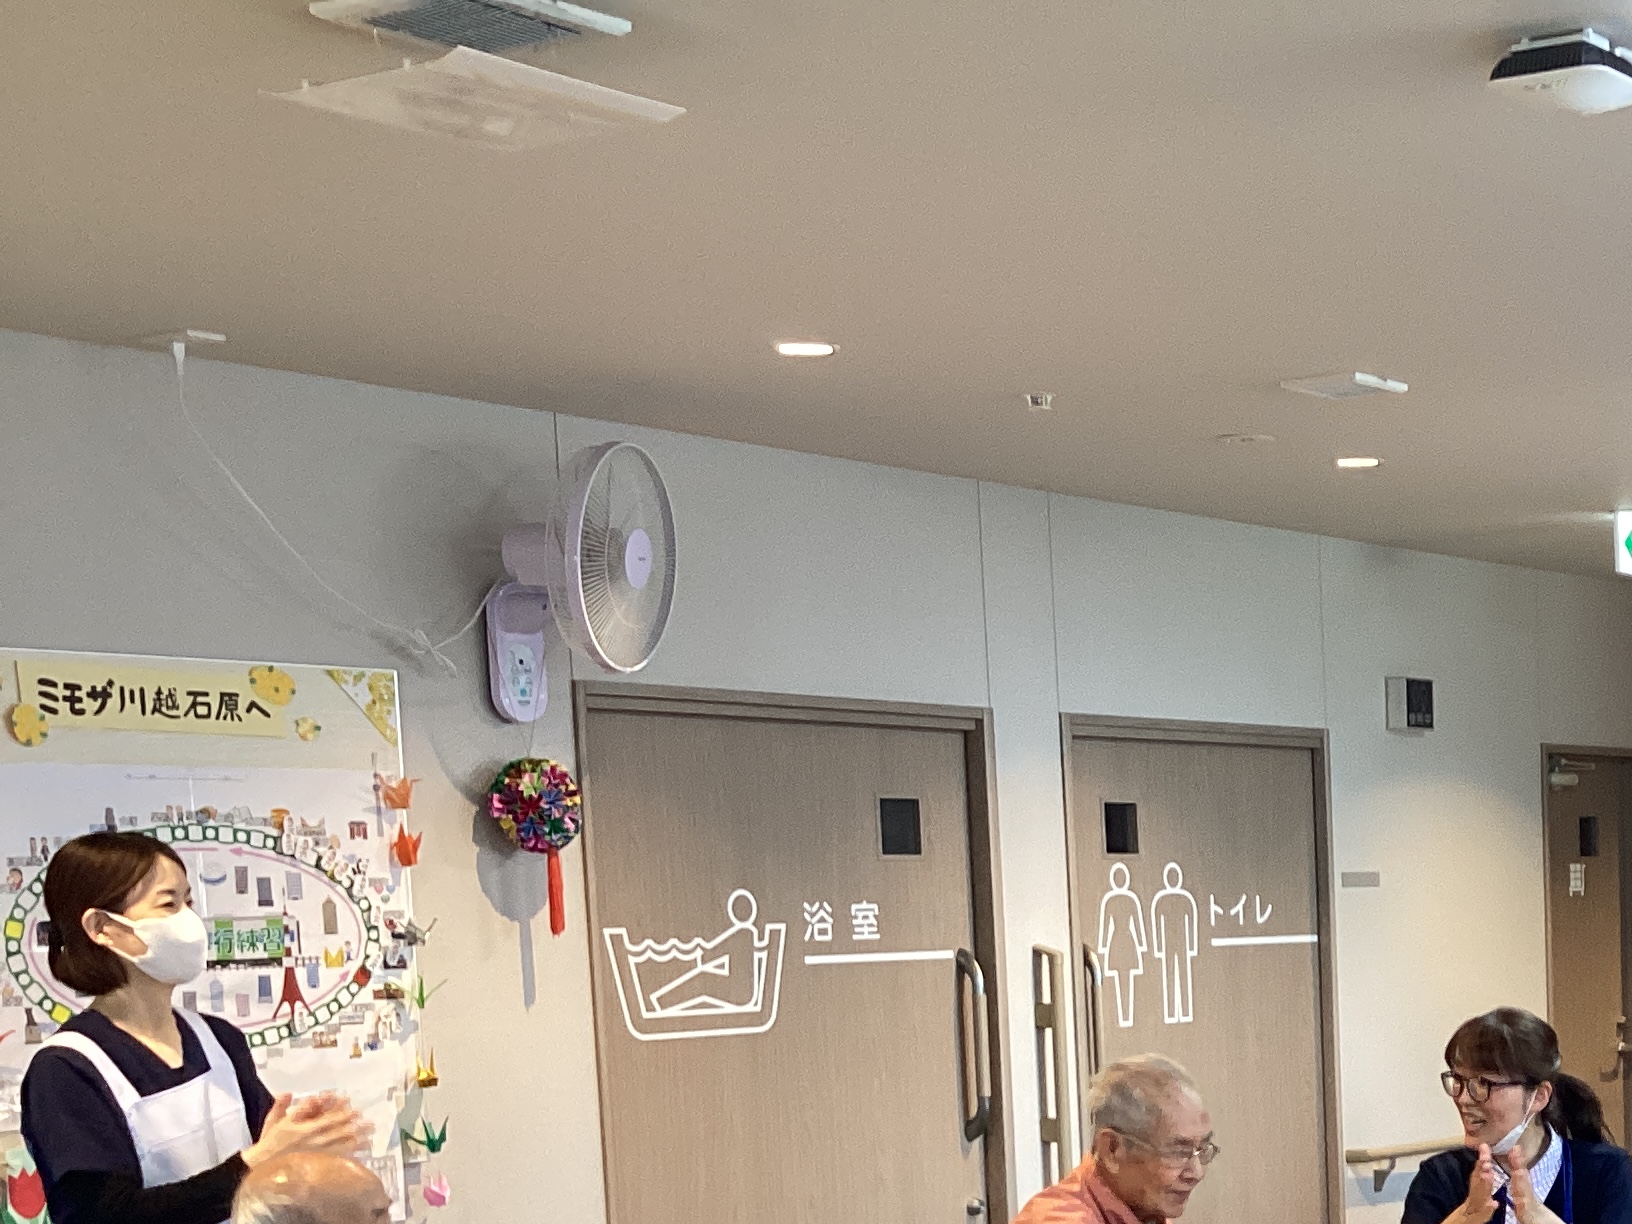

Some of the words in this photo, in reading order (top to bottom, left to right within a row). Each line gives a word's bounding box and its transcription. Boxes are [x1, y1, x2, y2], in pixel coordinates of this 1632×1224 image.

[37, 677, 271, 722] ミモザ川越石原へ
[803, 900, 881, 942] 浴室
[1209, 893, 1273, 927] トイレ
[207, 927, 284, 955] 行練習
